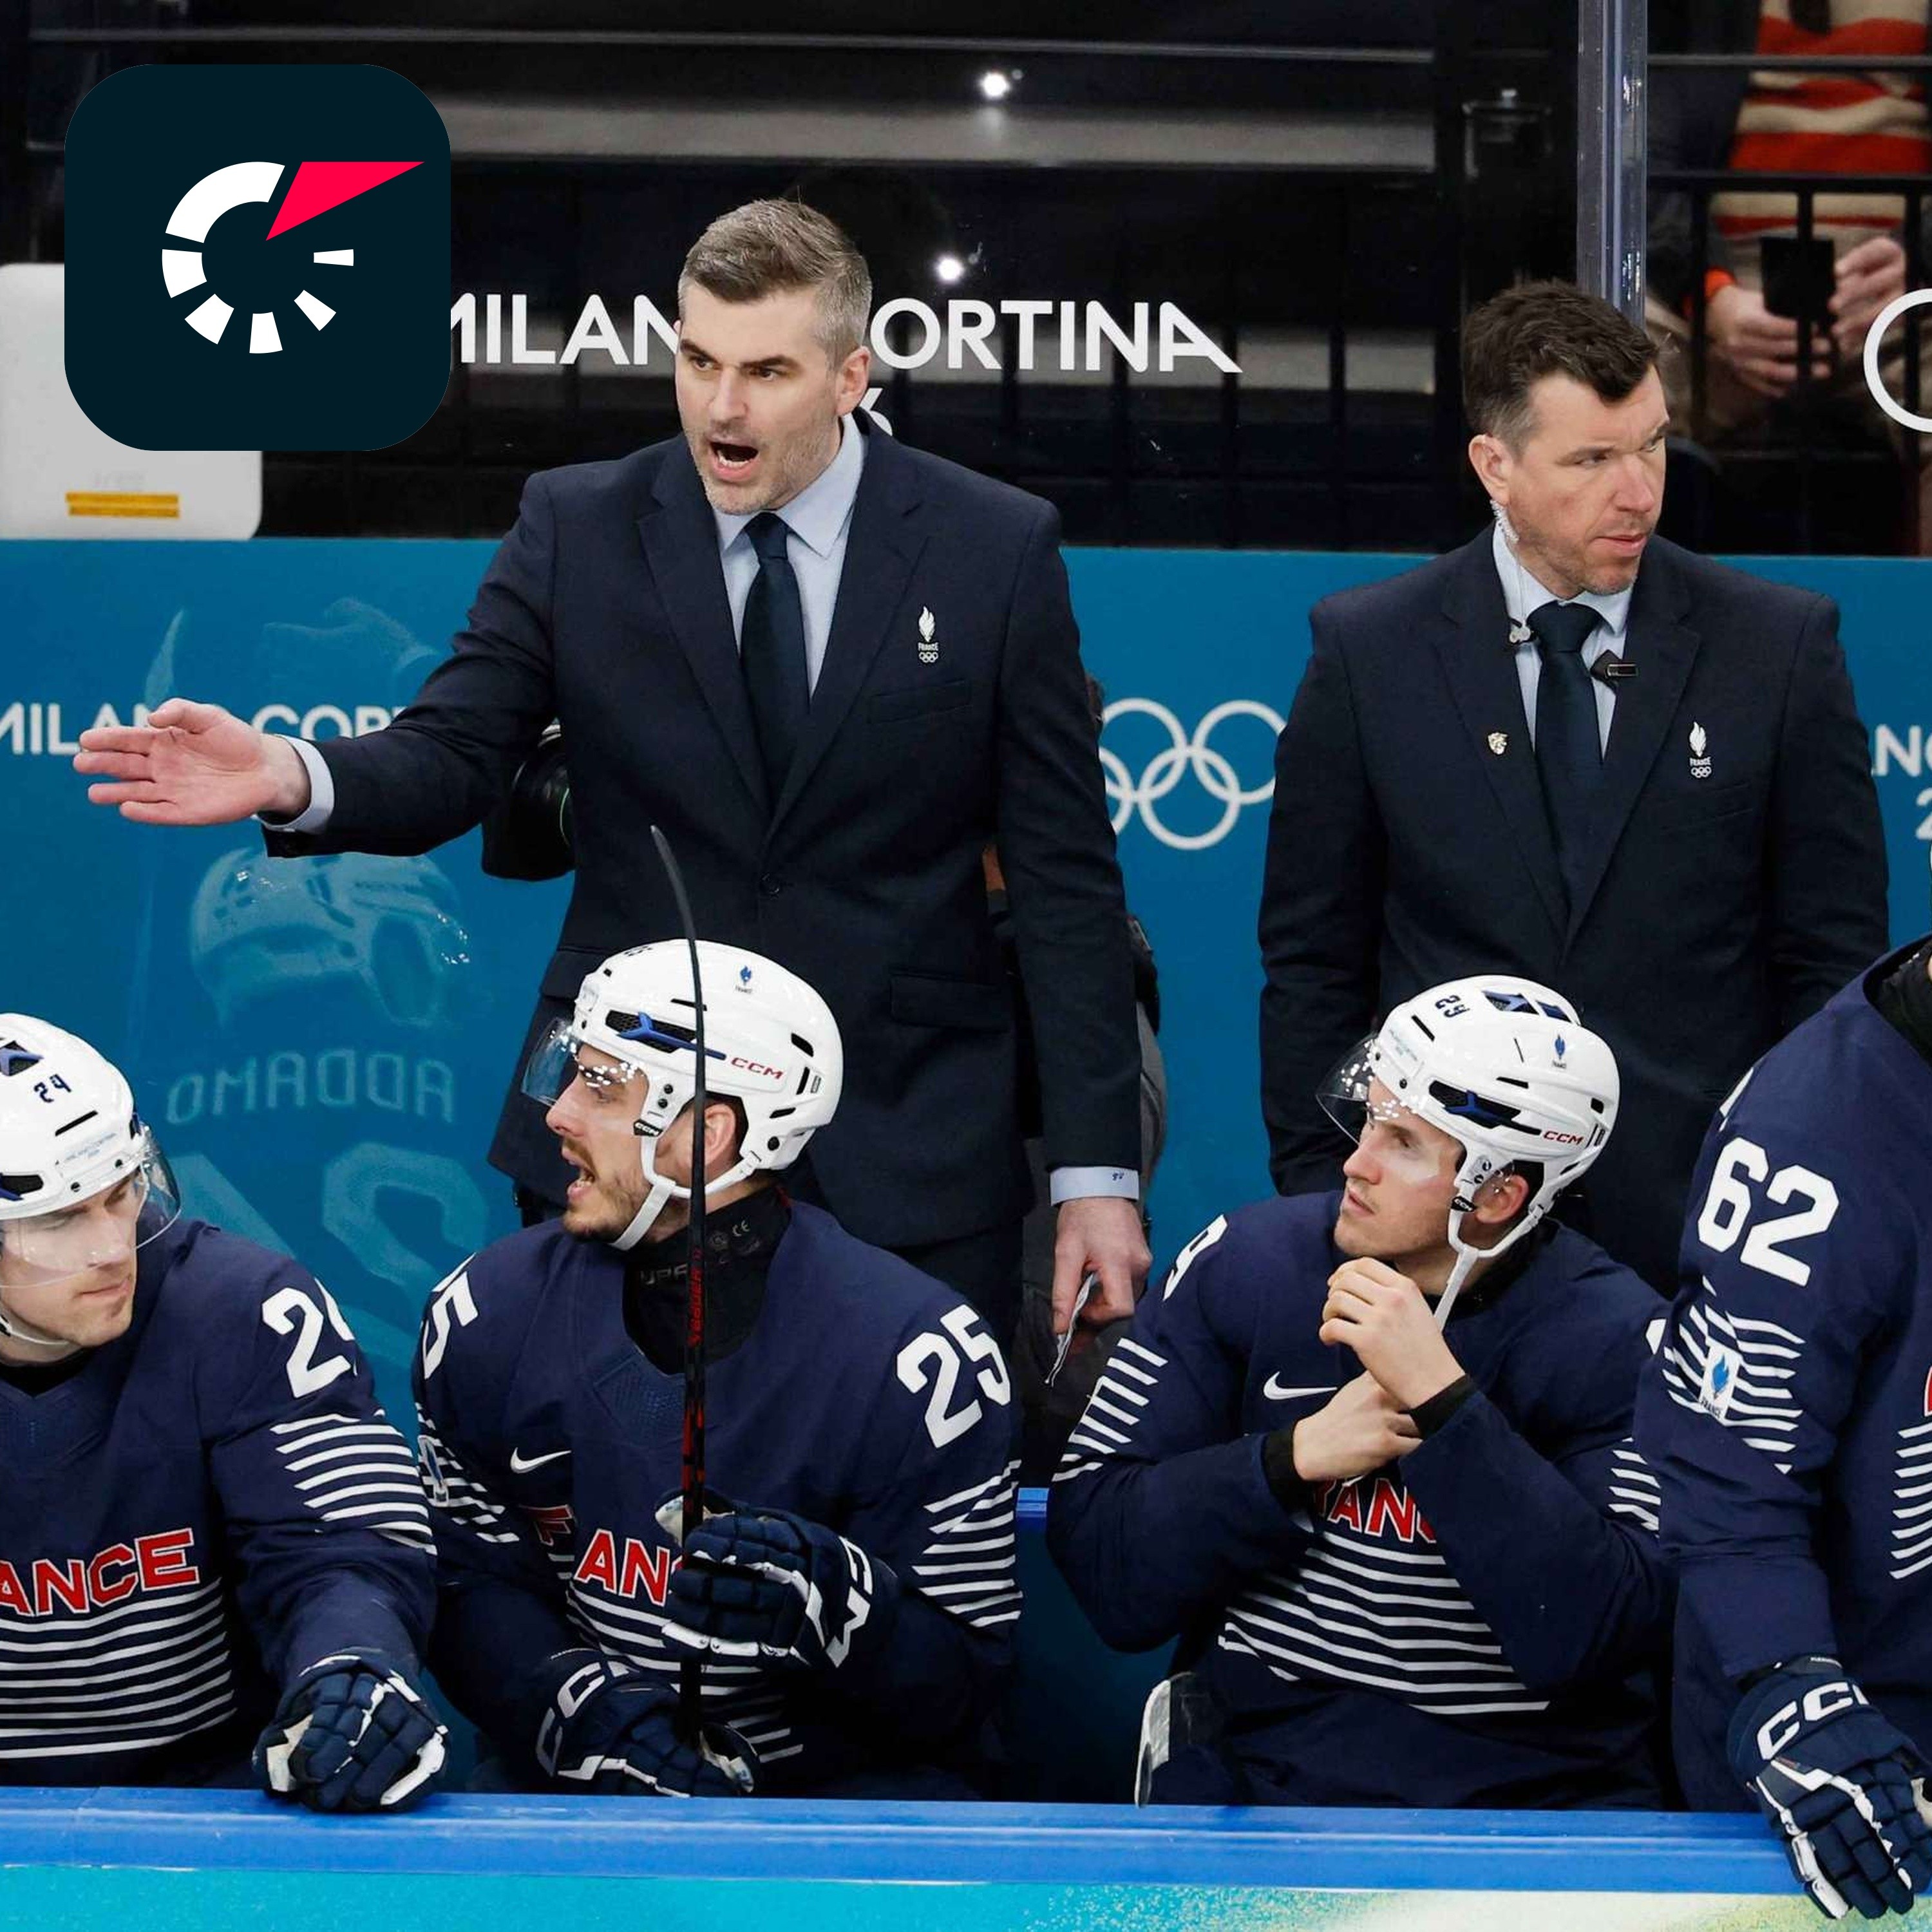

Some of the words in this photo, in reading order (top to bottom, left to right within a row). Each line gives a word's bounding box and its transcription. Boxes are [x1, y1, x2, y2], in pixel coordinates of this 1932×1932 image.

[451, 293, 677, 365] ILAN
[870, 298, 1243, 374] ORTINA
[33, 1074, 72, 1103] 24
[730, 1057, 783, 1080] CCM
[1543, 1130, 1584, 1146] CCM
[1698, 1137, 1839, 1287] 62
[896, 1303, 1011, 1449] 25
